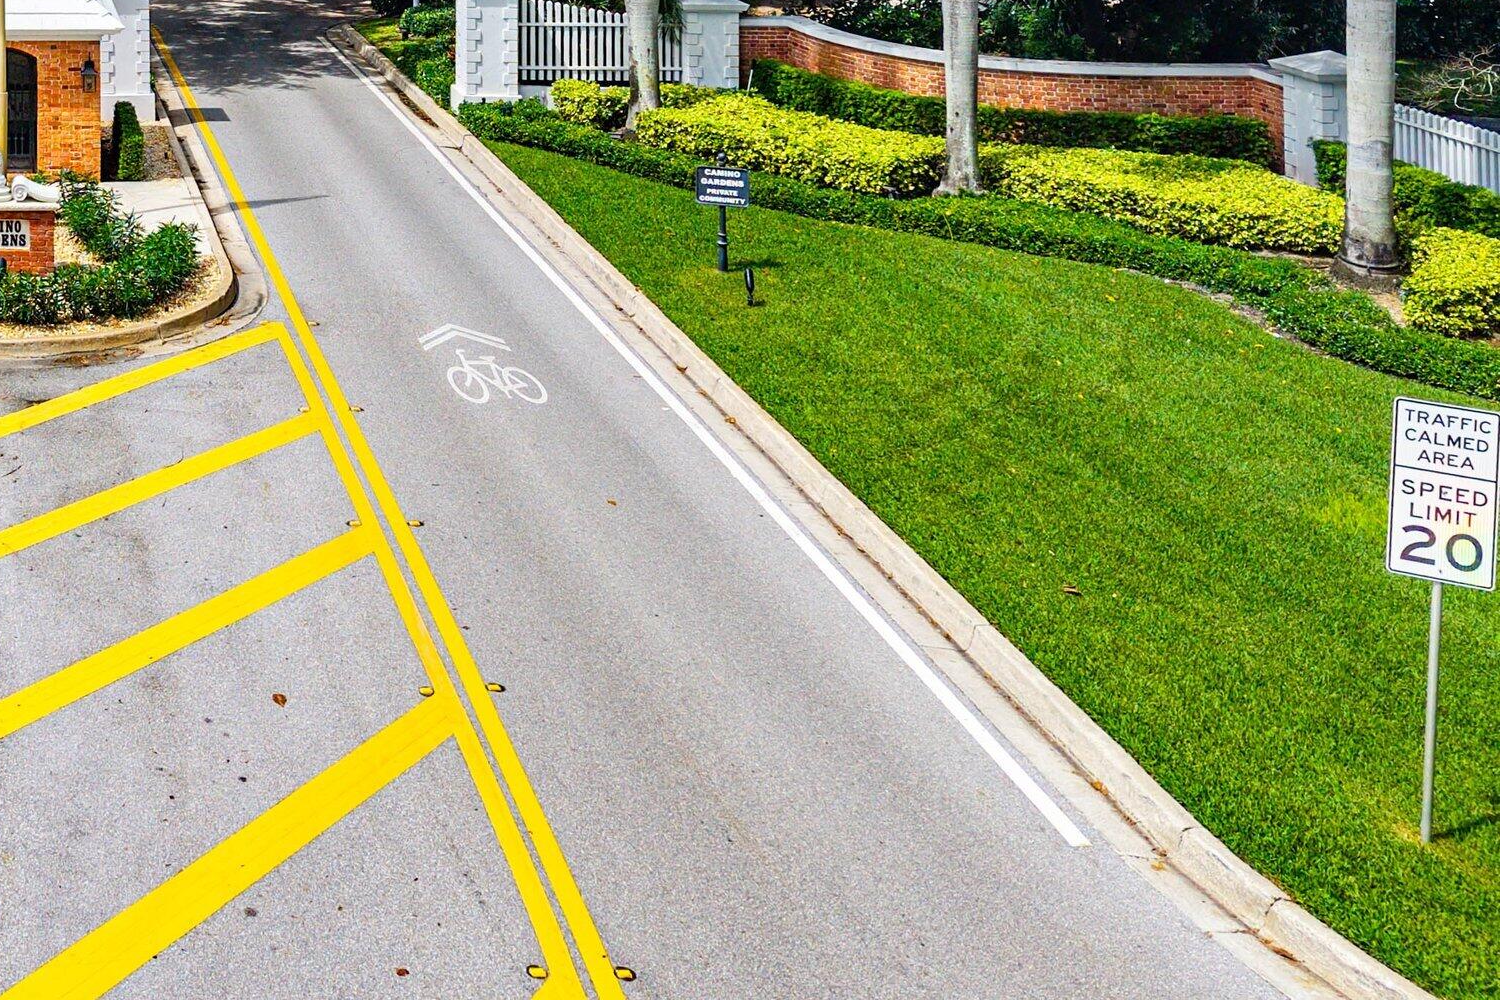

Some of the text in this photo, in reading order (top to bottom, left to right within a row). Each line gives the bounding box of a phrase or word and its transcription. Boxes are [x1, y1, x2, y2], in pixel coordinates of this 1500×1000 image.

[1405, 409, 1492, 434] TRAFFIC
[1404, 428, 1490, 453] CALMED
[1417, 450, 1475, 470] AREA
[1401, 479, 1489, 507] SPEED
[1409, 502, 1477, 527] LIMIT
[1400, 525, 1484, 572] 20
